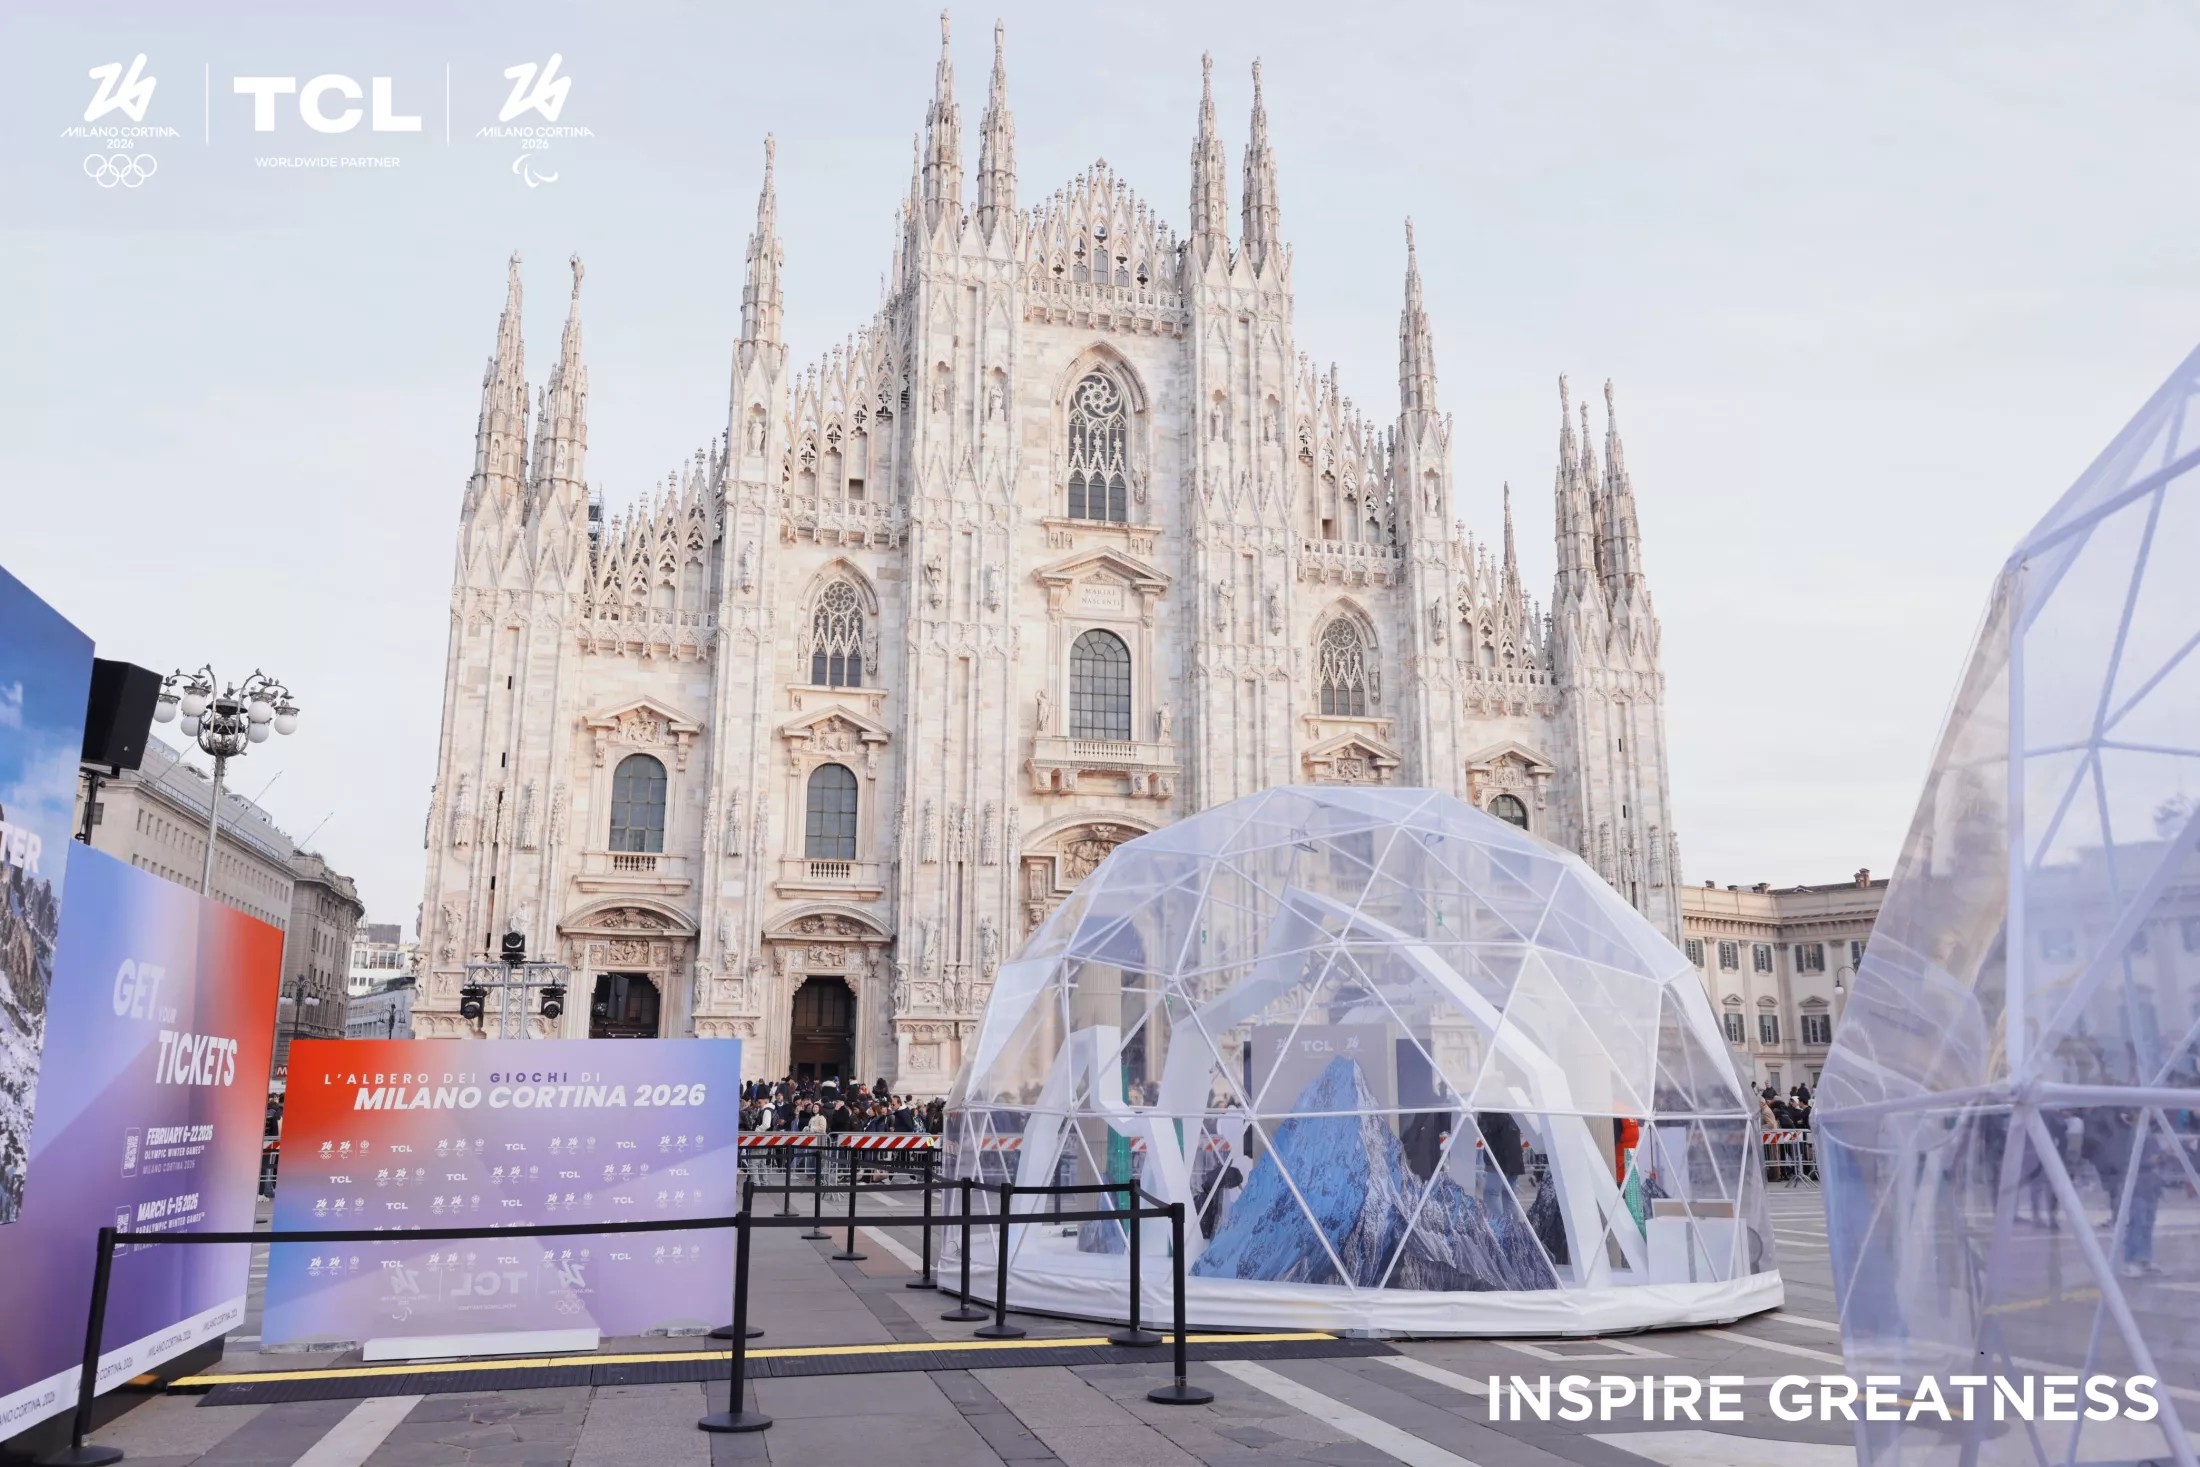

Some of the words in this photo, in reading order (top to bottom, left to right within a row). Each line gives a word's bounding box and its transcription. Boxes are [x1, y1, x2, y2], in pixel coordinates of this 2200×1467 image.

[113, 958, 165, 1021] GET
[158, 1006, 177, 1024] YOUR
[1301, 1040, 1334, 1051] TCL
[156, 1029, 237, 1087] TICKETS
[324, 1073, 429, 1085] L'ALBERO
[443, 1073, 476, 1084] DEI
[489, 1072, 568, 1083] GIOCHI
[581, 1072, 600, 1082] DI
[354, 1086, 482, 1110] MILANO
[488, 1085, 627, 1109] CORTINA
[633, 1083, 706, 1107] 2026
[146, 1126, 184, 1146] FEBRUARY
[197, 1124, 213, 1141] 2026
[144, 1149, 167, 1160] OLYMPIC
[391, 1145, 413, 1153] TCL
[505, 1143, 526, 1151] TCL
[616, 1141, 637, 1149] TCL
[329, 1175, 353, 1184] TCL
[446, 1173, 468, 1181] TCL
[559, 1171, 581, 1179] TCL
[669, 1168, 690, 1176] TCL
[137, 1199, 167, 1222] MARCH
[182, 1192, 199, 1212] 2026
[386, 1202, 408, 1210] TCL
[501, 1199, 523, 1207] TCL
[613, 1196, 634, 1204] TCL
[381, 1260, 404, 1269] TCL
[497, 1256, 519, 1264] TCL
[609, 1252, 632, 1260] TCL
[13, 1398, 42, 1420] CORTINA
